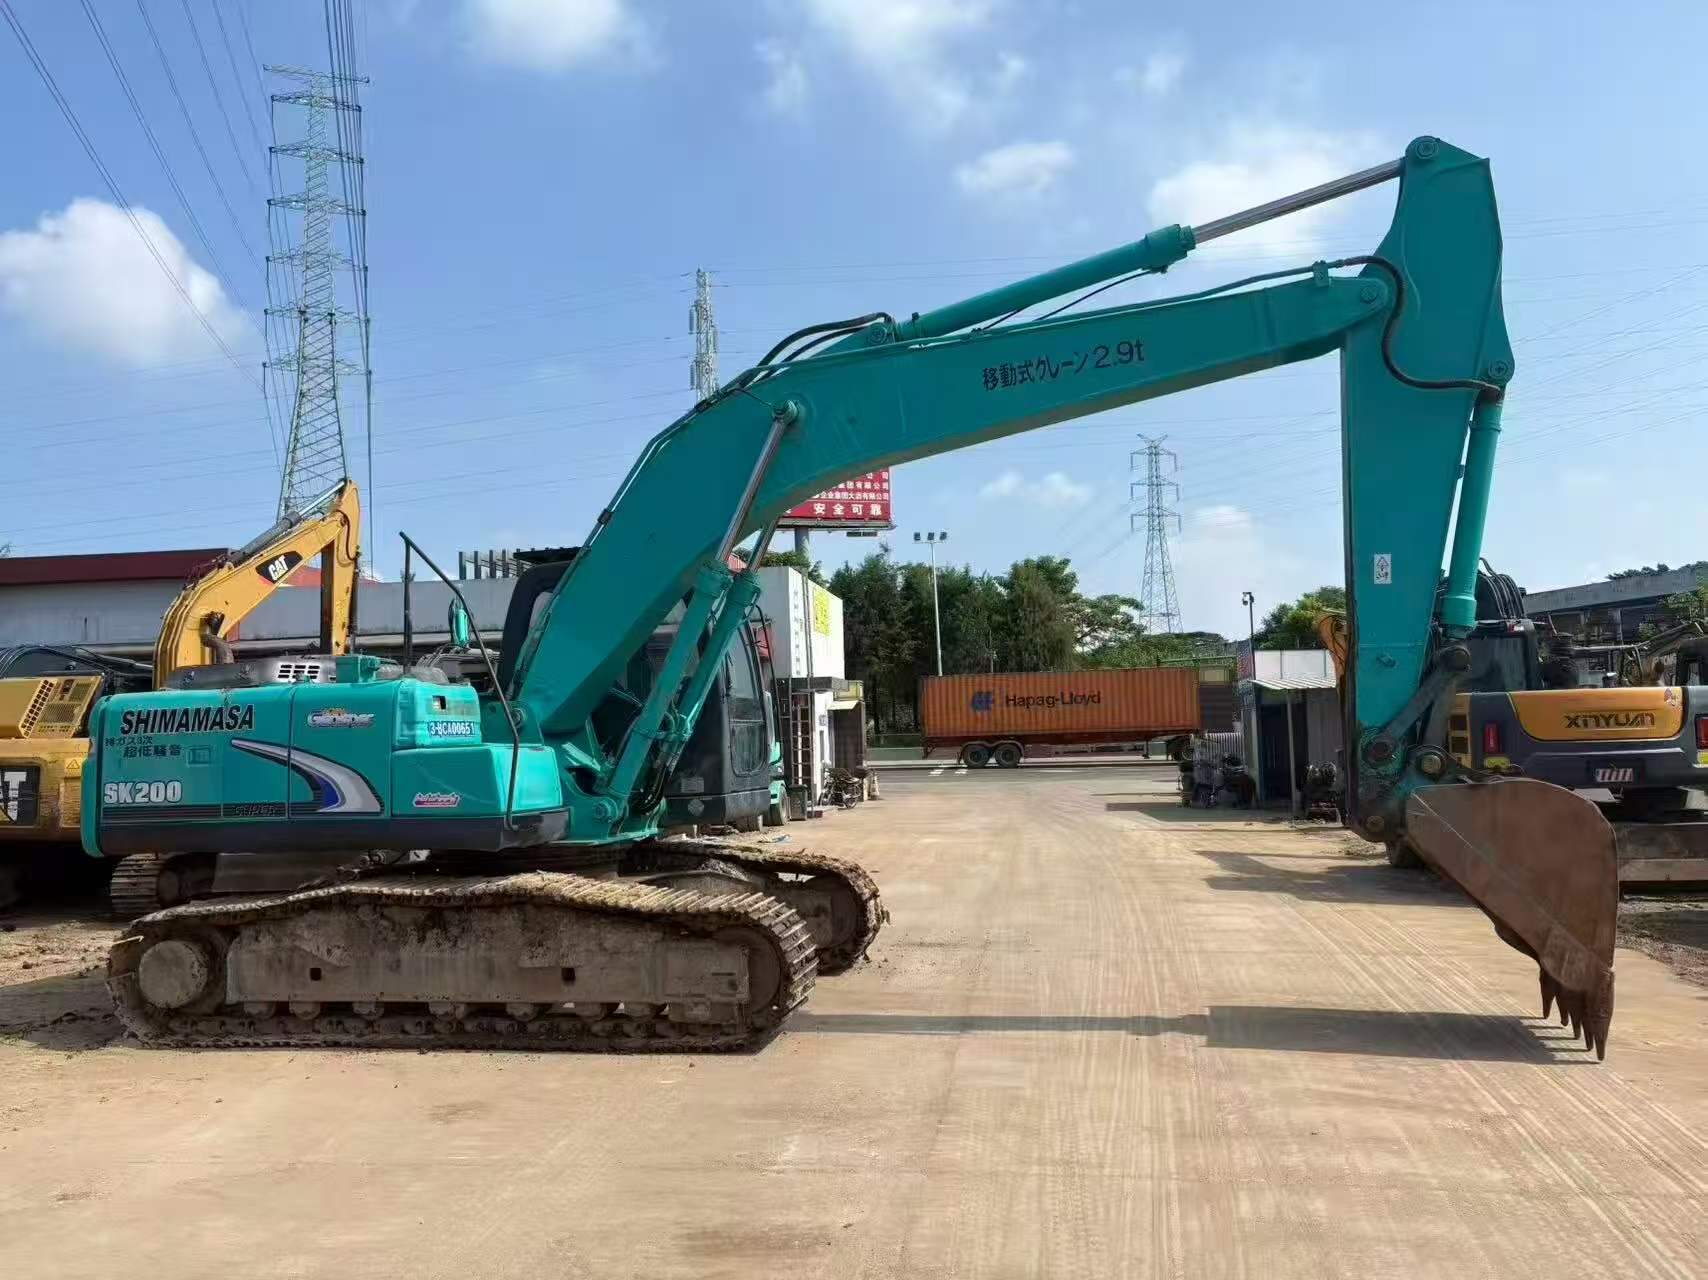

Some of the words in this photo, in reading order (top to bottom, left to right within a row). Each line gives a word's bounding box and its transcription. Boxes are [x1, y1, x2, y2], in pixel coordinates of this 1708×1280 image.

[268, 555, 289, 581] CAT
[1006, 691, 1101, 708] Hapag-Lloyd
[120, 704, 254, 735] SHIMAMASA
[104, 780, 182, 805] SK200
